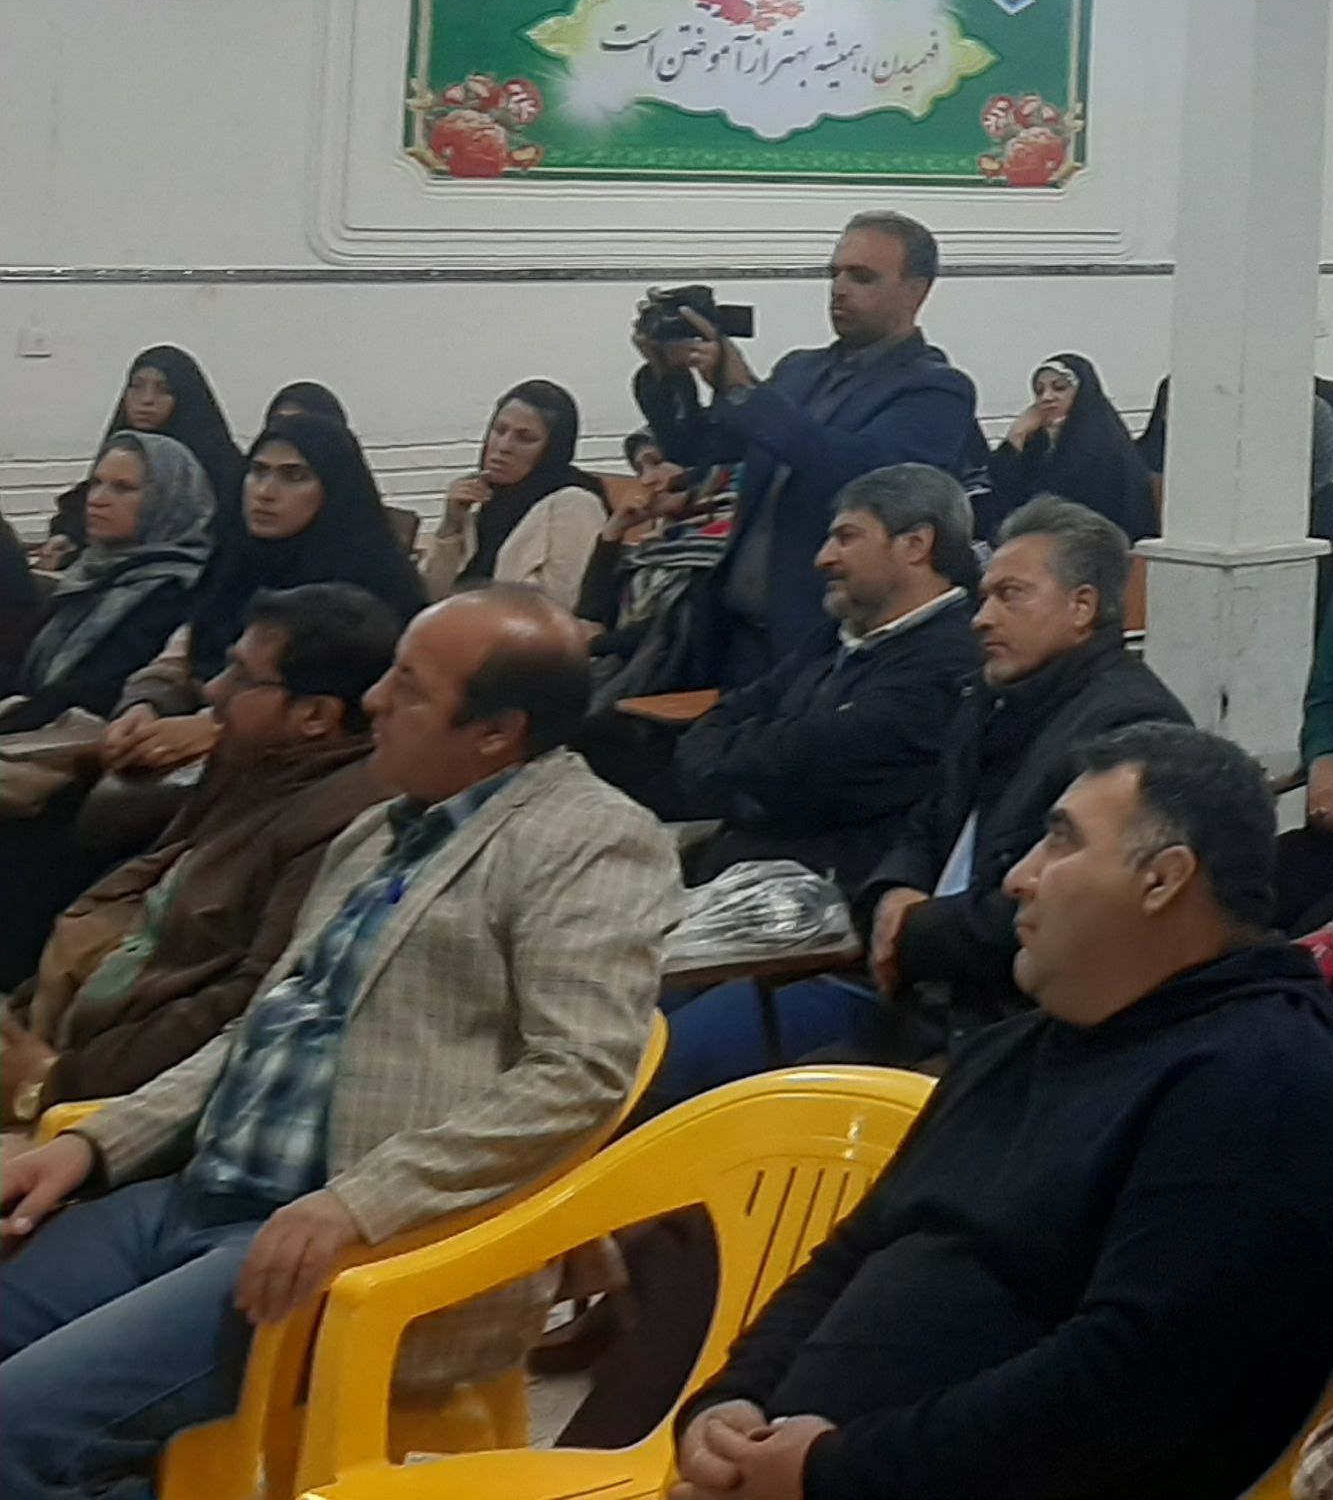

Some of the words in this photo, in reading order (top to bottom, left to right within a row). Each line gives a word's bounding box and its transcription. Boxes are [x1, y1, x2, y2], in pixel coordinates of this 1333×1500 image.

[600, 22, 663, 70] است
[656, 24, 756, 82] آموختن
[744, 37, 770, 74] از
[758, 28, 813, 88] بهتر
[814, 31, 862, 88] همیشه
